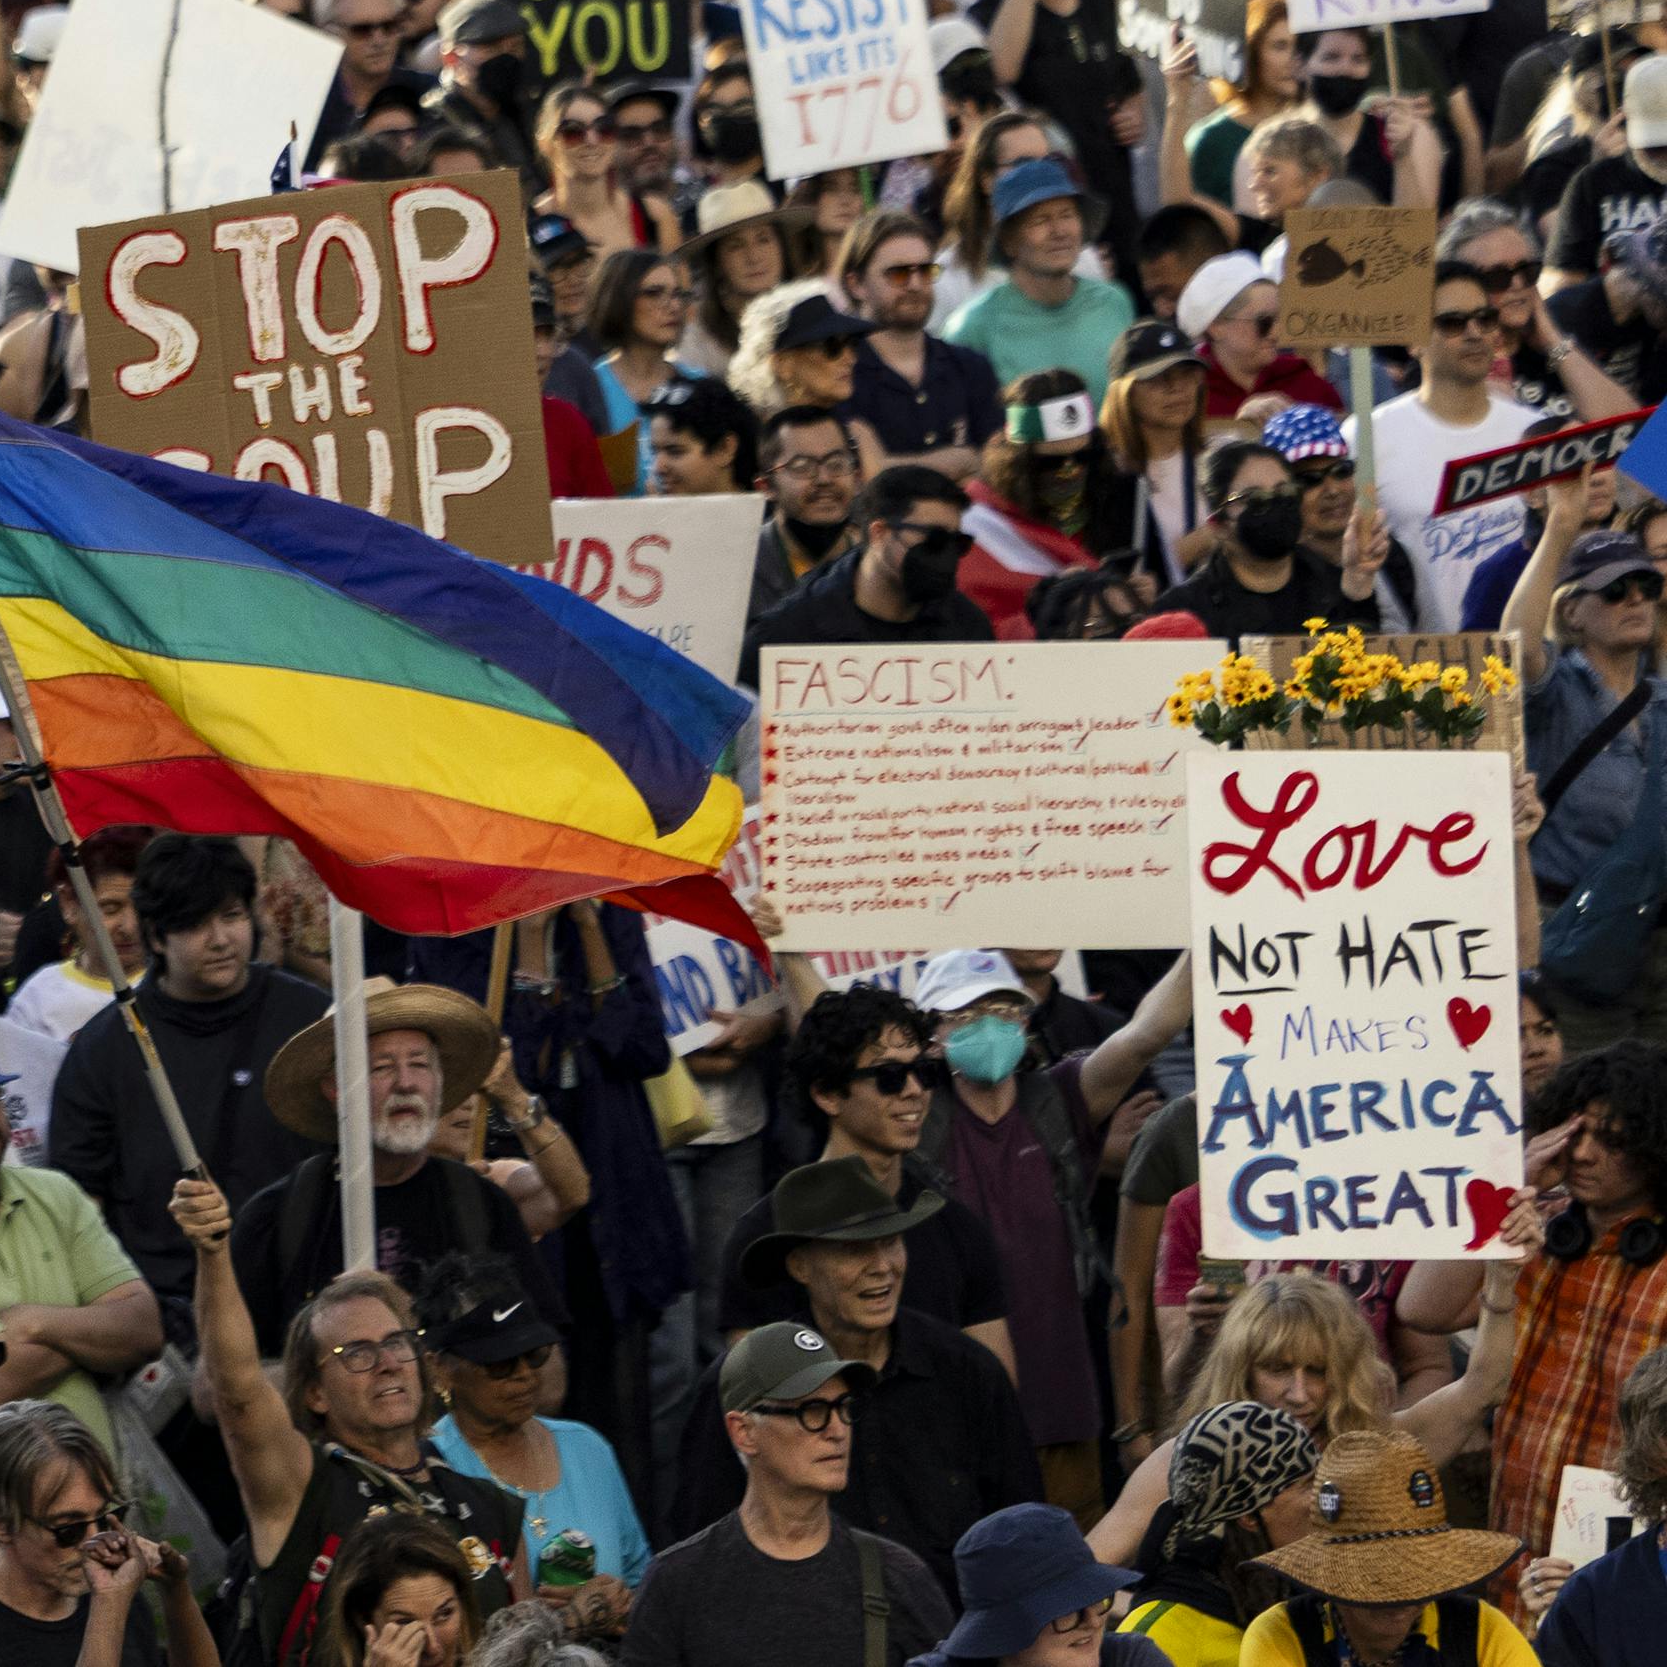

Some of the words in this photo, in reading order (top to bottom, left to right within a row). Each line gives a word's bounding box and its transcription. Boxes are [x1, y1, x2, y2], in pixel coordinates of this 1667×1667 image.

[523, 0, 669, 78] YOU
[788, 44, 851, 86] LIKE
[787, 48, 923, 159] 1776
[105, 182, 499, 400] STOP
[233, 352, 373, 431] THE
[774, 656, 1016, 710] FASCISM:
[783, 718, 881, 738] Authoritarian
[929, 718, 969, 734] often
[1017, 716, 1084, 738] arrogant
[1089, 716, 1140, 733] leader
[784, 746, 855, 762] Extreme
[862, 742, 953, 759] nationalism
[977, 739, 1063, 754] militarism
[878, 767, 941, 783] electoral
[946, 763, 1020, 783] democracy
[786, 791, 857, 806] liberalism
[797, 809, 835, 825] belief
[992, 795, 1031, 813] social
[784, 832, 844, 849] Disdain
[920, 827, 967, 839] human
[973, 823, 1024, 843] rights
[1045, 817, 1082, 837] free
[1087, 821, 1144, 840] speech
[922, 851, 961, 862] mass
[967, 845, 1012, 861] media
[1202, 768, 1492, 902] Love
[891, 869, 955, 892] specific
[964, 872, 1012, 893] groups
[1017, 868, 1034, 880] to
[1038, 861, 1079, 881] shift
[1084, 863, 1134, 880] blame
[1141, 857, 1171, 877] for
[786, 900, 844, 915] nations
[850, 897, 929, 917] problems
[1209, 922, 1314, 990] NOT
[1337, 915, 1509, 992] HATE
[1279, 1006, 1431, 1061] MAKES
[1200, 1053, 1527, 1154] AMERICA
[1228, 1153, 1475, 1243] GREAT
